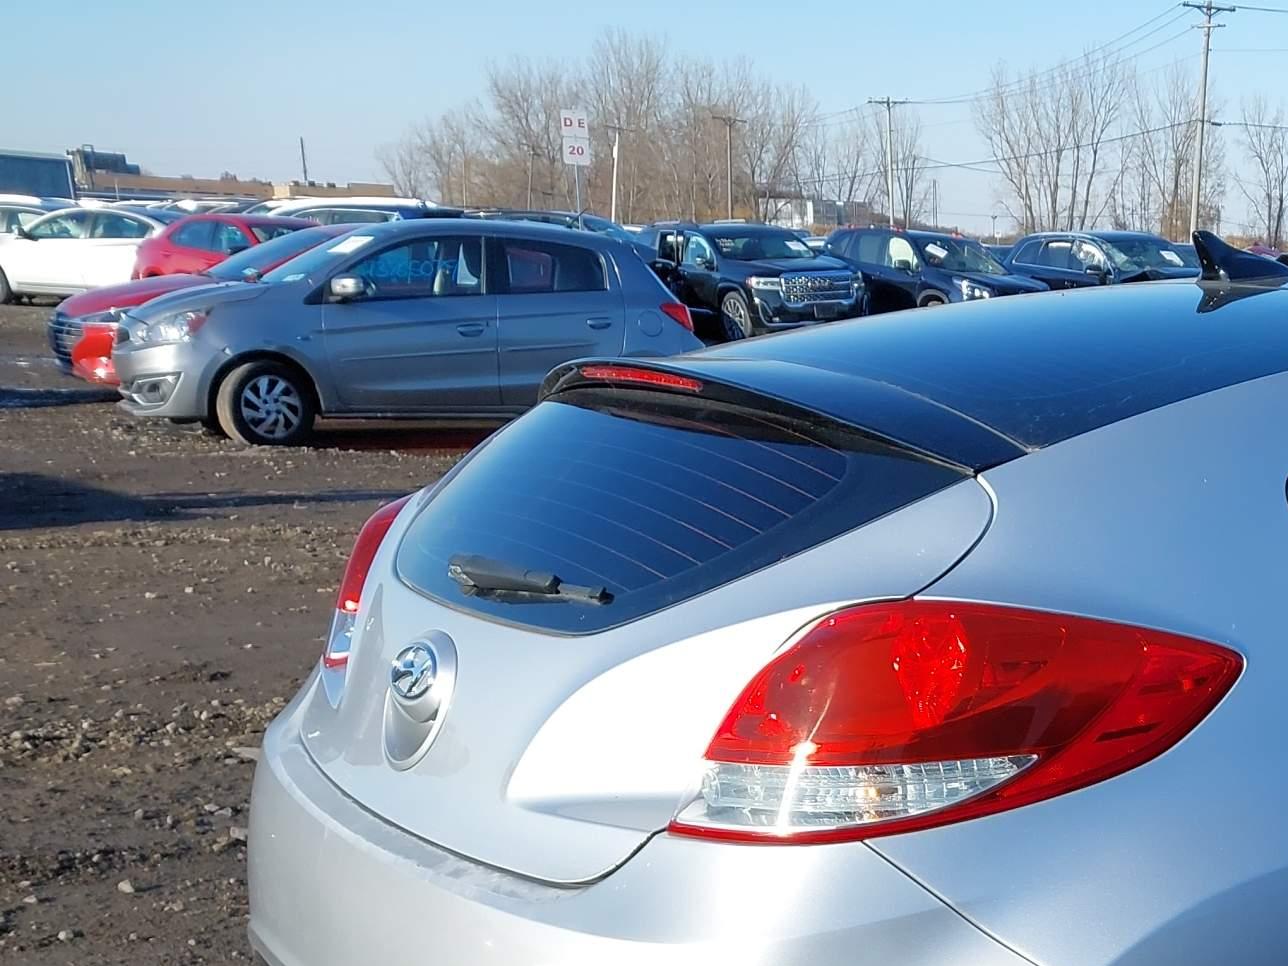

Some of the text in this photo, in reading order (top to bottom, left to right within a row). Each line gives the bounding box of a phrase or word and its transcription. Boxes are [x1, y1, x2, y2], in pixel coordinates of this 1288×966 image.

[564, 117, 585, 128] D E
[568, 145, 584, 156] 20
